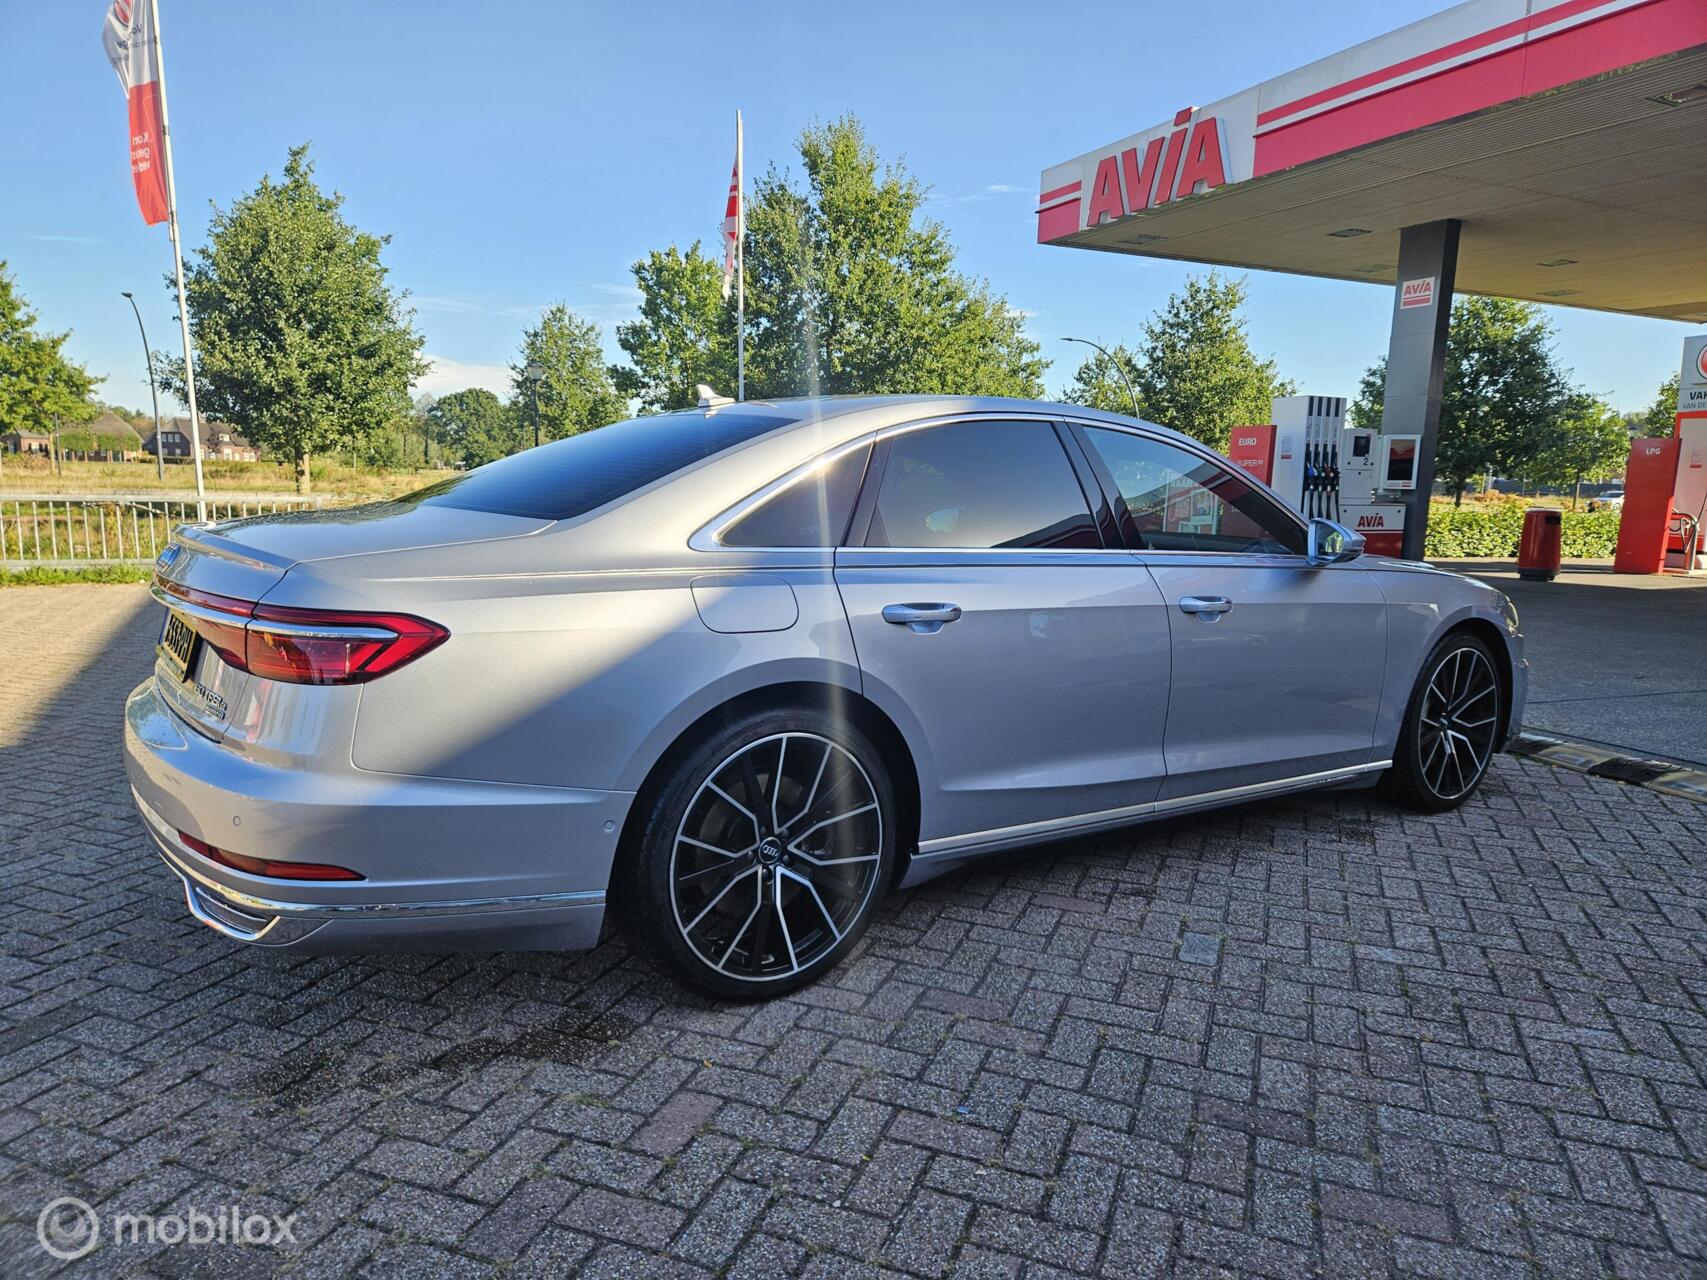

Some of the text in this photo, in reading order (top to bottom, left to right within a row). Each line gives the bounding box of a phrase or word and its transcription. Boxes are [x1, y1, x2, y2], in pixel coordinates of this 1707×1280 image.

[1238, 437, 1257, 446] EURO
[1646, 447, 1661, 455] LPG
[1363, 457, 1369, 466] 2
